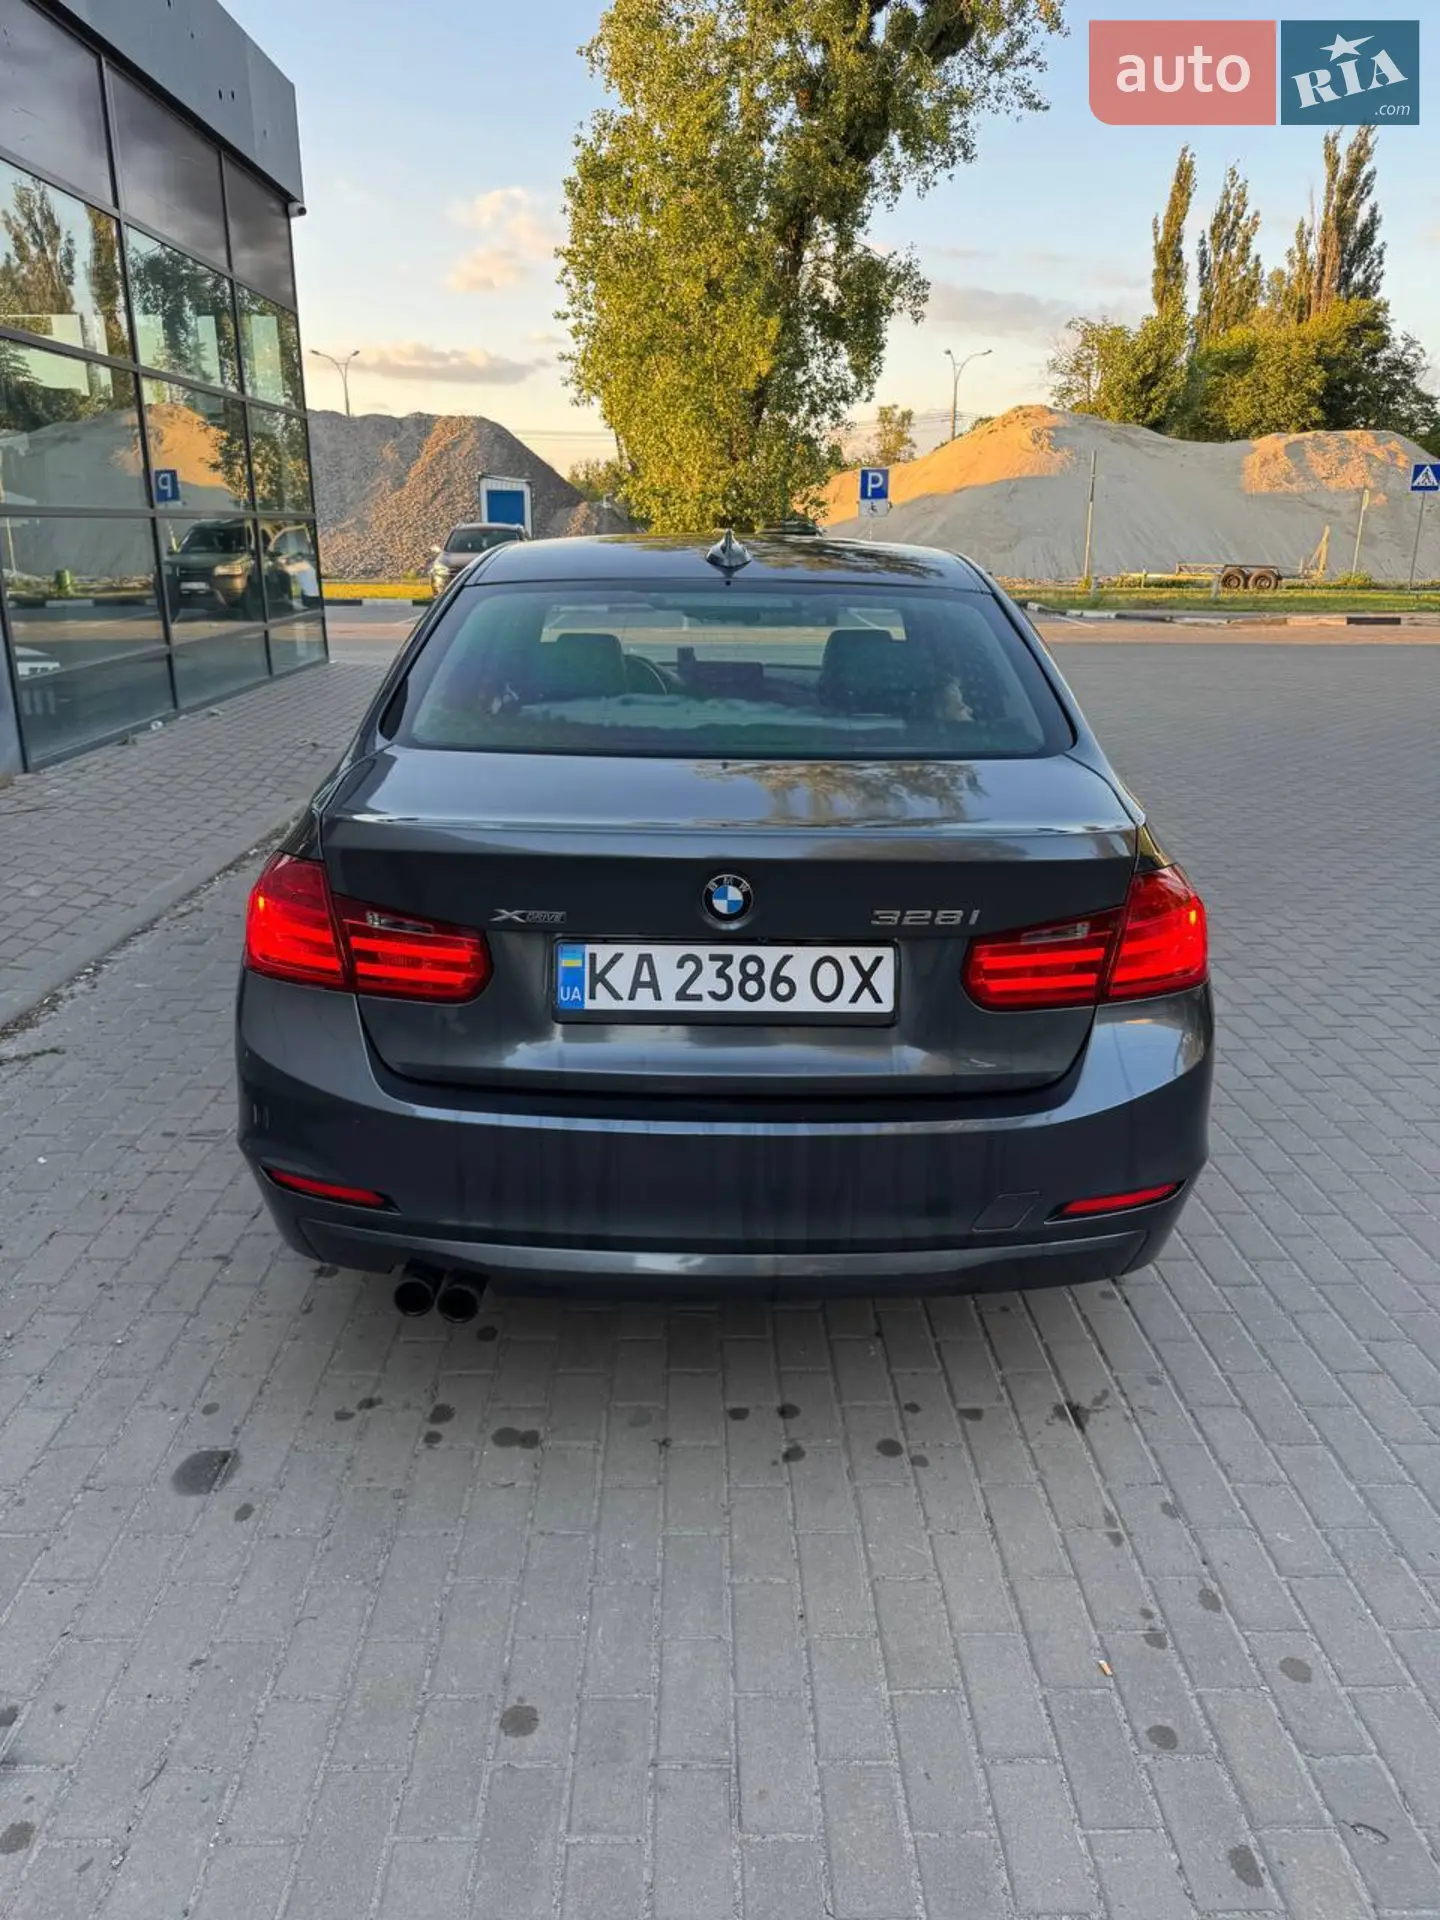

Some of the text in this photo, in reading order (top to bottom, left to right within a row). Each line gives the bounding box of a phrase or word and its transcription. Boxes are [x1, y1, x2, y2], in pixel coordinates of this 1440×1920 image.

[867, 472, 884, 497] P
[588, 952, 885, 1004] KA 2386 OX
[560, 987, 581, 1002] UA
